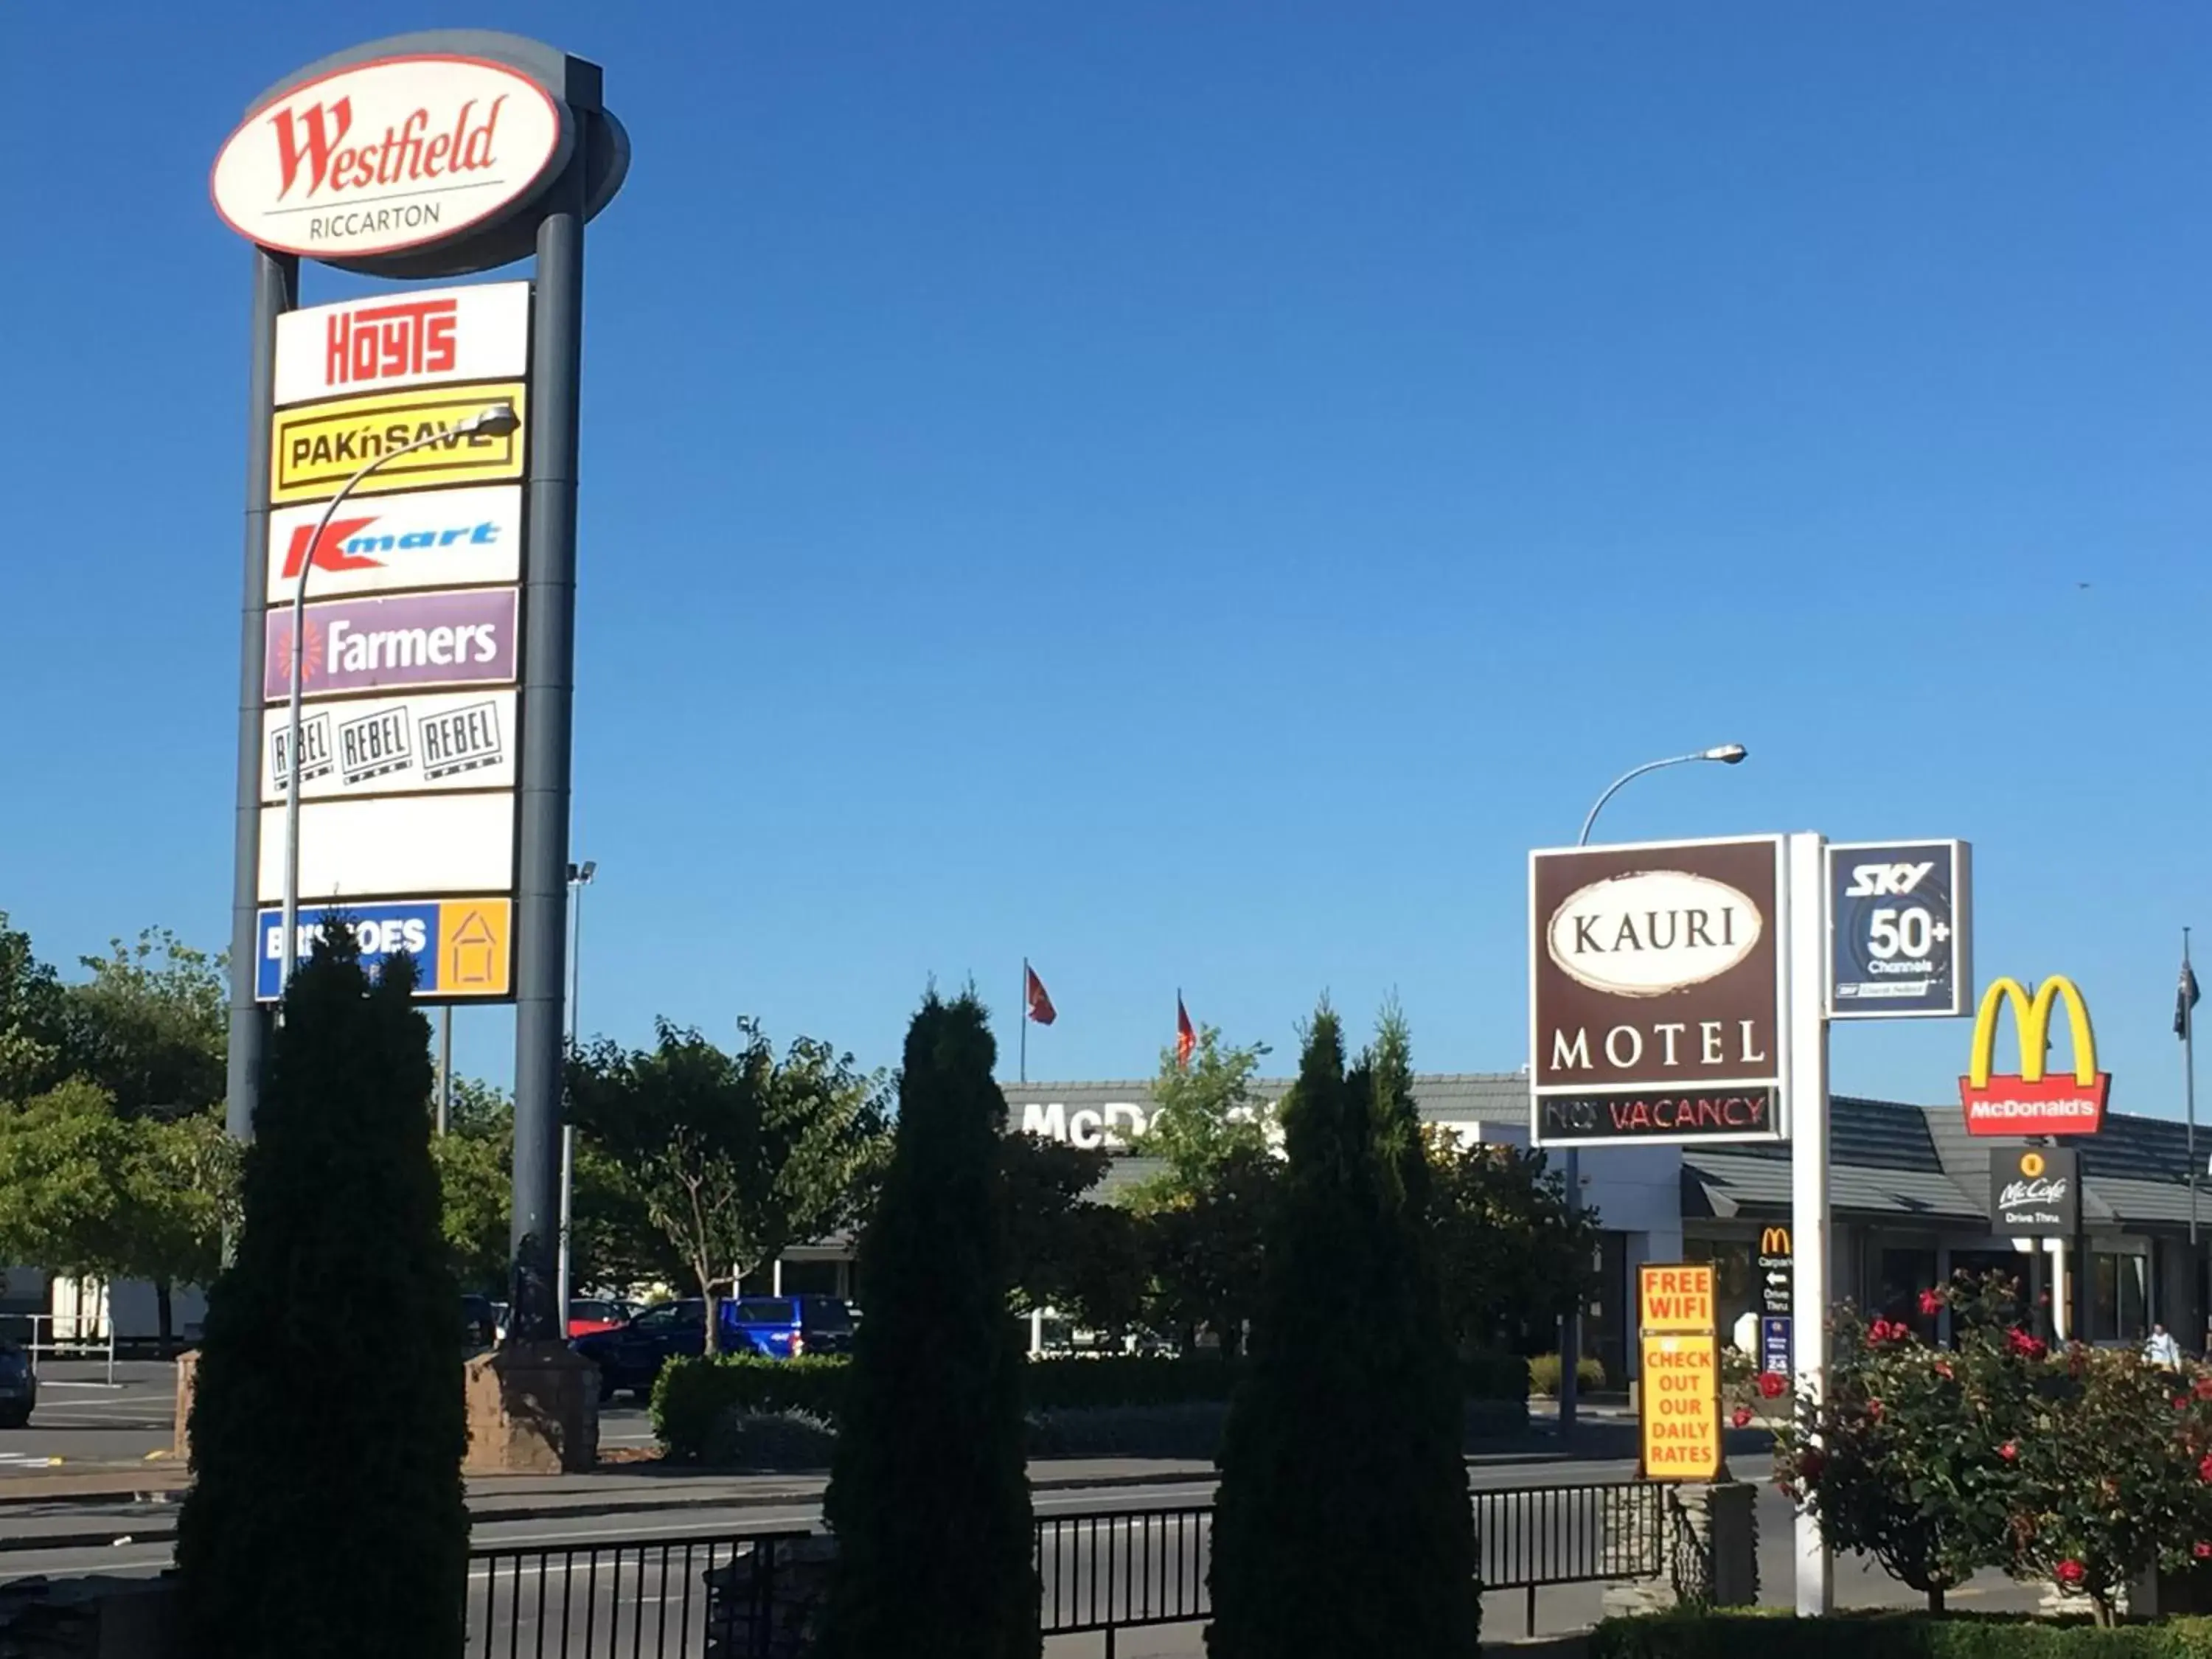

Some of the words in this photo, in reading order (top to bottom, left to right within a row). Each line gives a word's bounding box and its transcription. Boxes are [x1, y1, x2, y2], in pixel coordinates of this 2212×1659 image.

[267, 93, 509, 203] Westfield
[310, 203, 441, 240] RICCARTON
[327, 620, 496, 673] Farmers
[344, 714, 406, 766] REBEL
[425, 709, 494, 762] REBEL
[1845, 861, 1935, 897] SKY
[267, 919, 426, 959] BRIOES
[1573, 907, 1735, 954] KAURI
[1550, 1020, 1765, 1070] MOTEL
[1545, 1102, 1599, 1129] NO
[1608, 1096, 1766, 1130] VACANCY
[1970, 1099, 2095, 1119] McDonald's
[1645, 1271, 1708, 1294] FREE
[1649, 1297, 1707, 1319] WIFI
[1646, 1351, 1711, 1368] CHECK
[1658, 1375, 1700, 1391] OUT
[1658, 1399, 1701, 1416] OUR
[1652, 1423, 1709, 1439] DAILY
[1651, 1446, 1711, 1463] RATES
